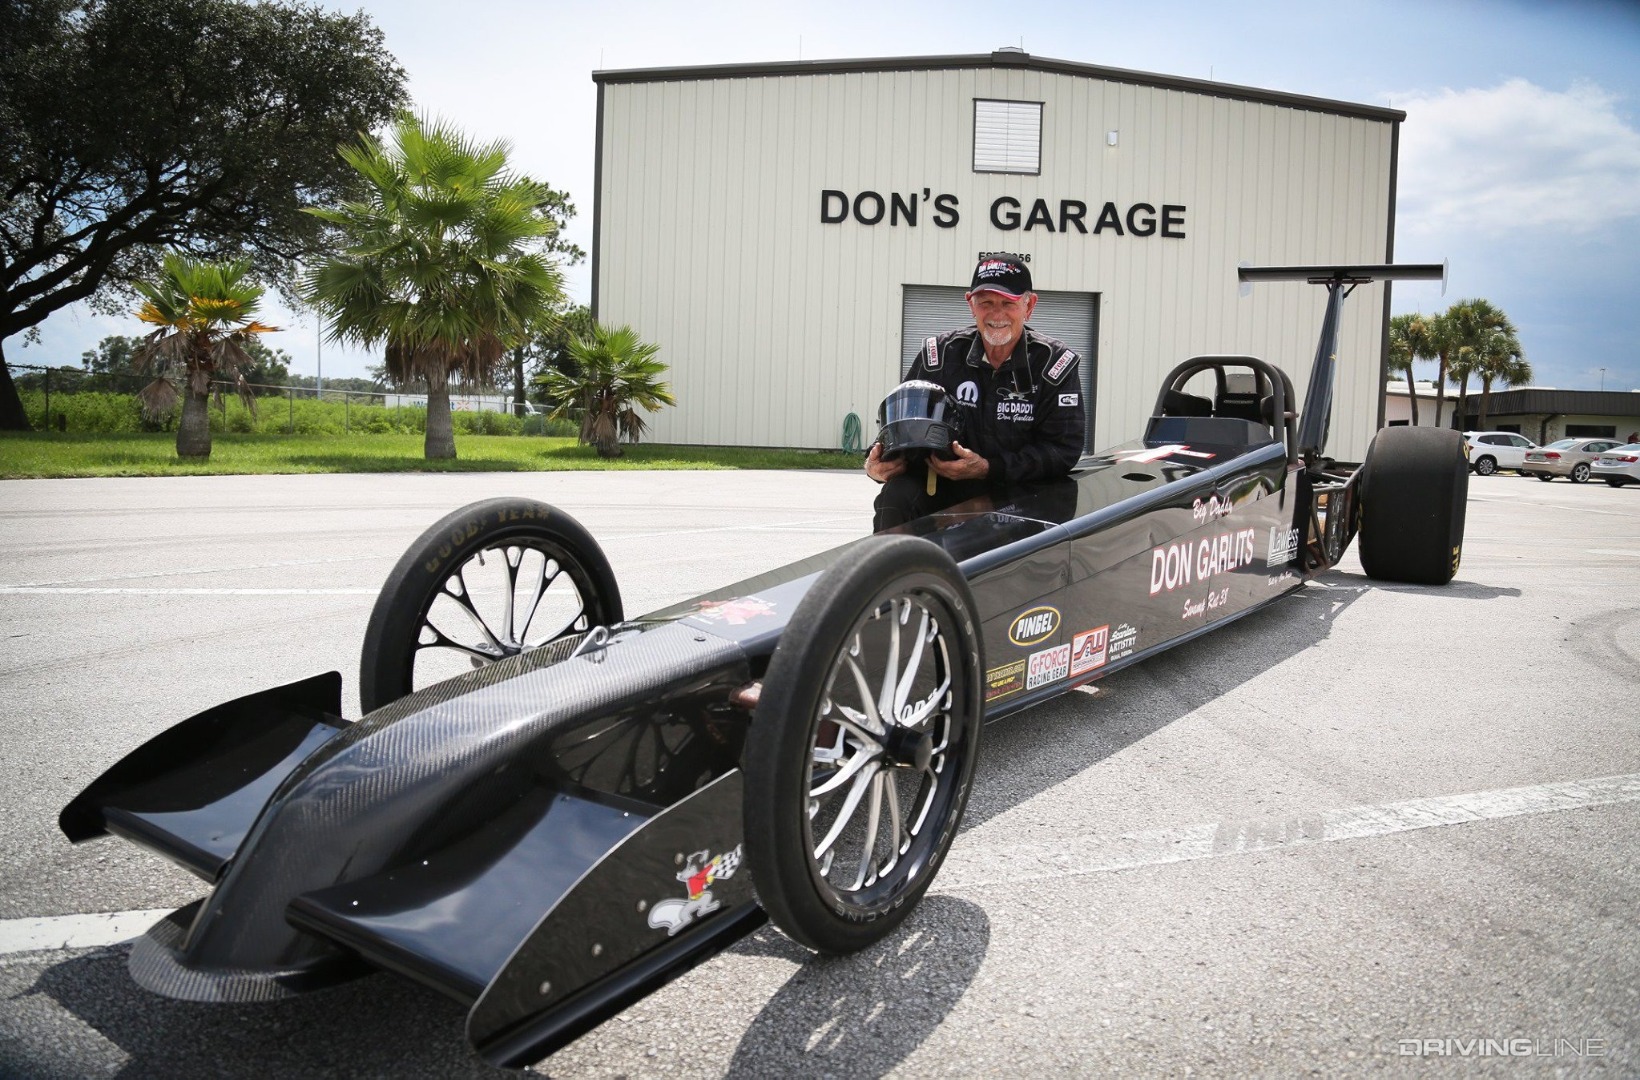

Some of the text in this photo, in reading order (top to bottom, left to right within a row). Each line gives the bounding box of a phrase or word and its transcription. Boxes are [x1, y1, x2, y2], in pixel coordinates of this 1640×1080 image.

[820, 188, 1187, 239] DON'S GARAGE
[996, 402, 1034, 414] BIG DADDY
[1193, 495, 1233, 524] Big Daddy
[1149, 528, 1255, 597] DON GARLITS
[1182, 598, 1206, 620] Swamp
[1206, 591, 1220, 611] Rat
[1015, 611, 1053, 641] PINGEL
[1108, 635, 1137, 655] ARTISTRY
[1030, 647, 1068, 675] G-FORCE
[1028, 671, 1051, 689] RACING
[1052, 665, 1067, 680] GEAR
[928, 782, 968, 868] WELD
[835, 895, 904, 922] RACING
